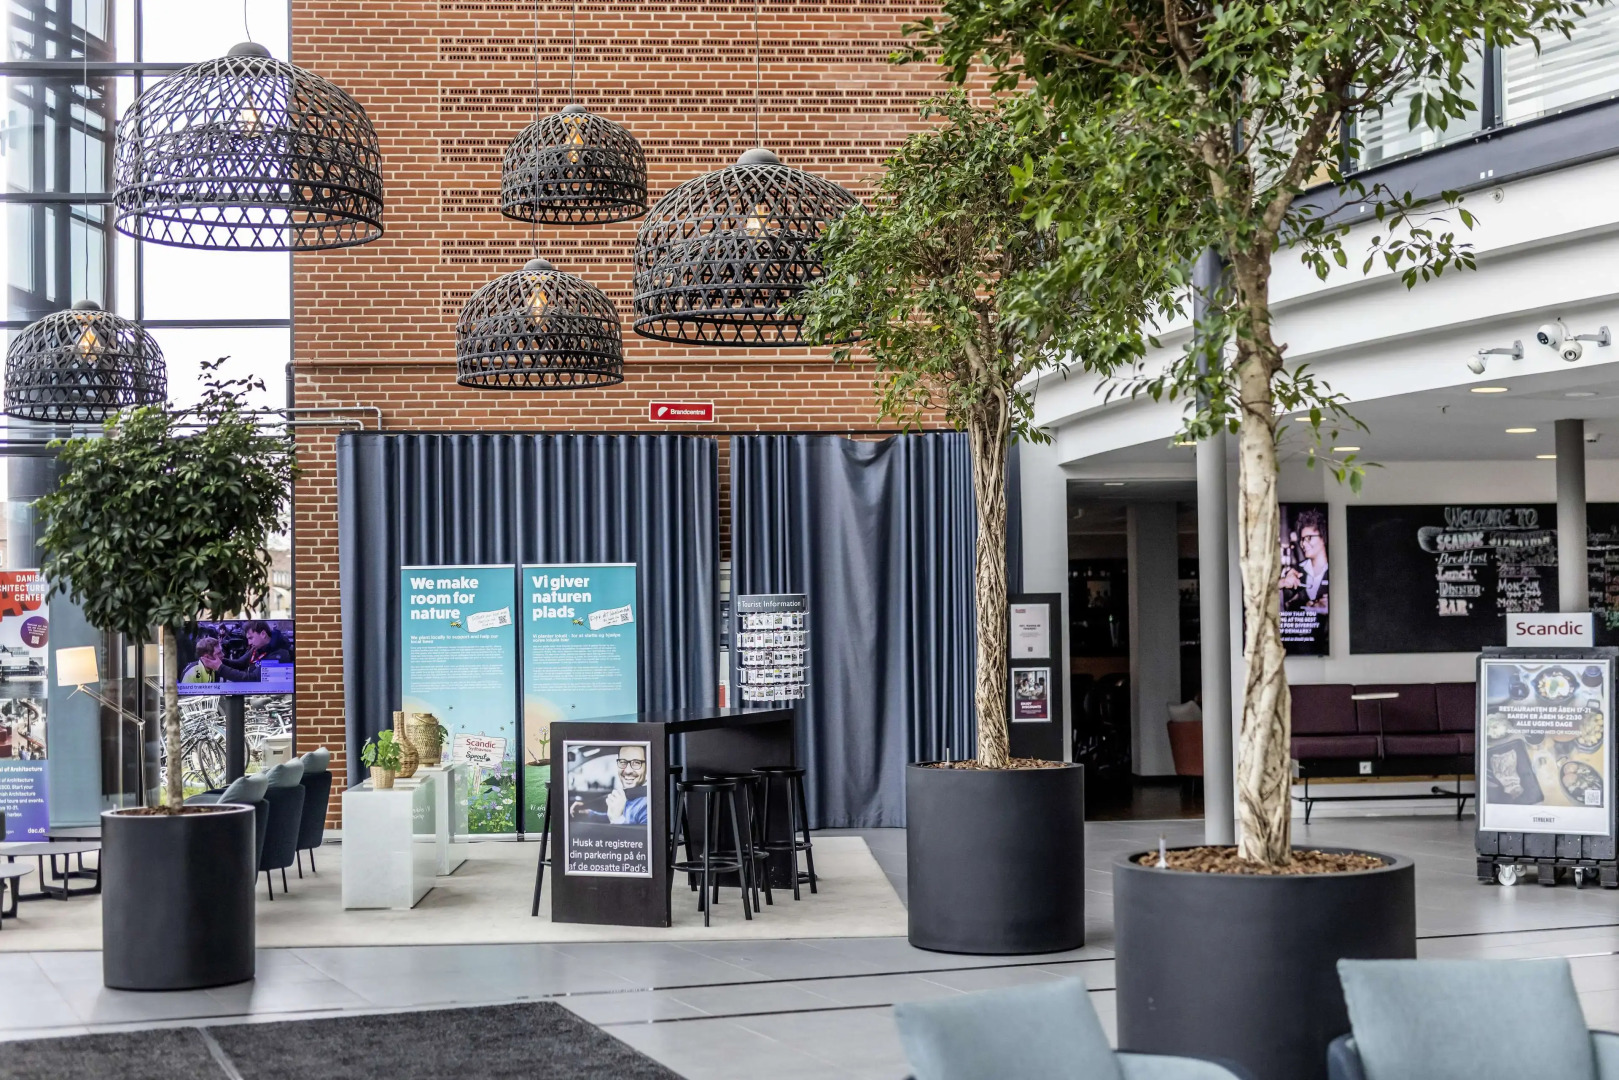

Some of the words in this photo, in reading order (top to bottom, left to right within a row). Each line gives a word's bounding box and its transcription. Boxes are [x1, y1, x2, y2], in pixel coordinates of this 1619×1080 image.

[1514, 508, 1538, 527] TO
[1439, 550, 1487, 564] Breakfast
[16, 574, 45, 582] DANISH
[410, 577, 434, 590] We
[437, 576, 479, 589] make
[532, 575, 548, 588] Vi
[550, 575, 590, 591] giver
[14, 594, 45, 602] CENTER
[410, 593, 451, 605] room
[453, 591, 475, 604] for
[532, 591, 592, 603] naturen
[742, 600, 761, 608] Tourist
[1438, 598, 1469, 616] BAR
[410, 607, 460, 620] nature
[532, 605, 575, 621] plads
[1516, 621, 1583, 636] Scandic
[466, 738, 496, 749] Scandic
[572, 838, 593, 847] Husk
[595, 839, 604, 848] at
[605, 839, 643, 849] registrere
[570, 850, 582, 859] din
[584, 850, 622, 862] parkering
[624, 851, 634, 861] på
[636, 851, 646, 861] én
[578, 862, 588, 871] de
[590, 863, 620, 872] opsatte
